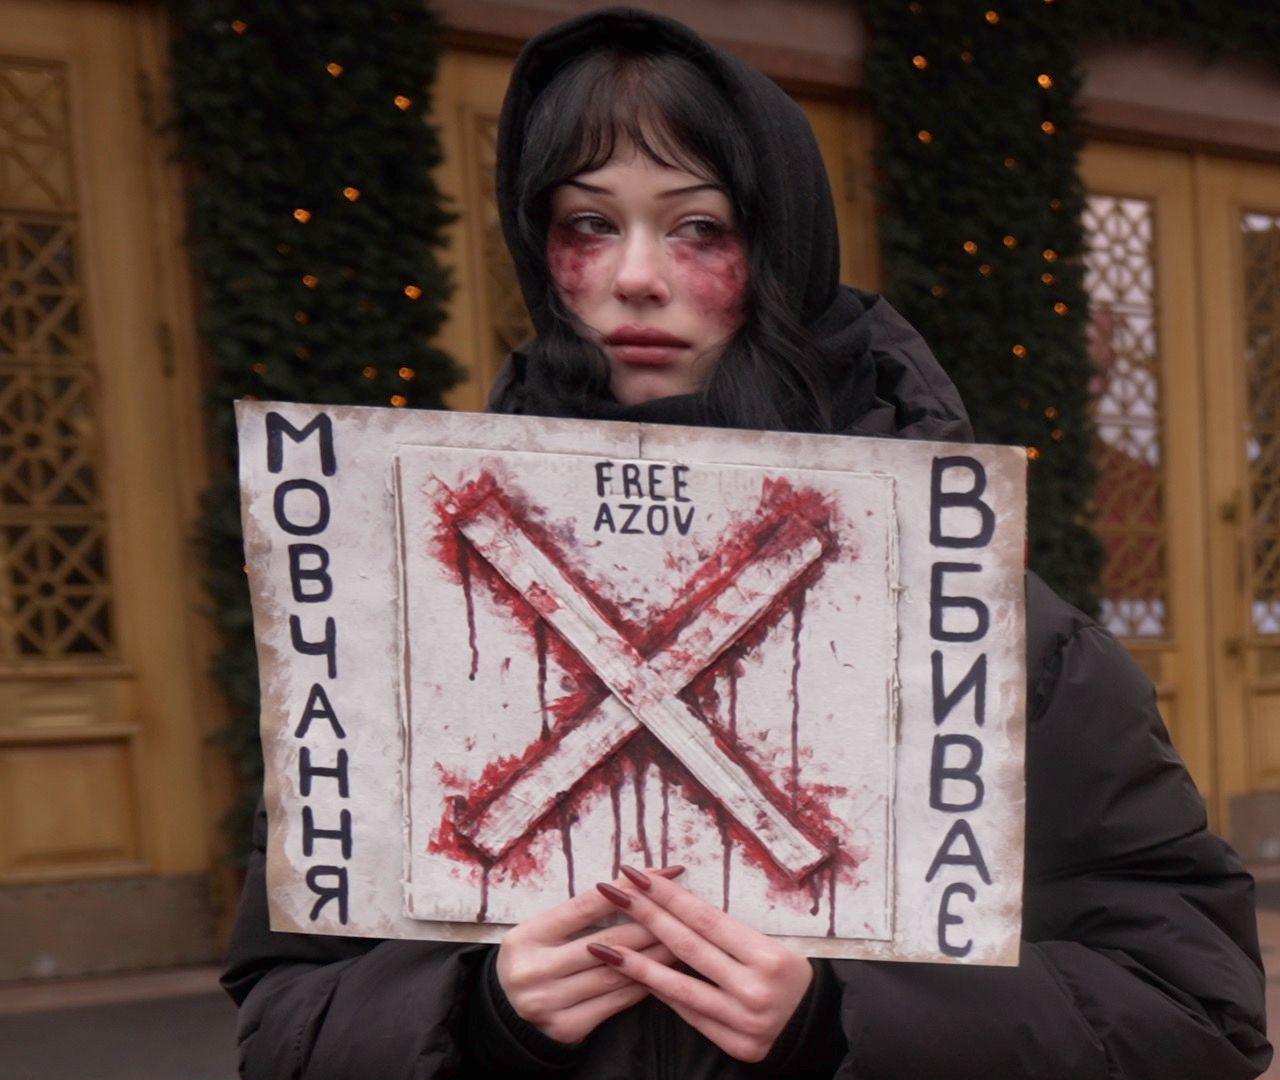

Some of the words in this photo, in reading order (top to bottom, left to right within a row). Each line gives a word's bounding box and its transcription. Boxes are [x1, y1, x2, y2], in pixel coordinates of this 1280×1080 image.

[593, 503, 695, 537] AZOV
[596, 461, 691, 503] FREE
[265, 411, 353, 925] МОВЧАННЯ
[925, 455, 996, 958] ВБИВАЄ
